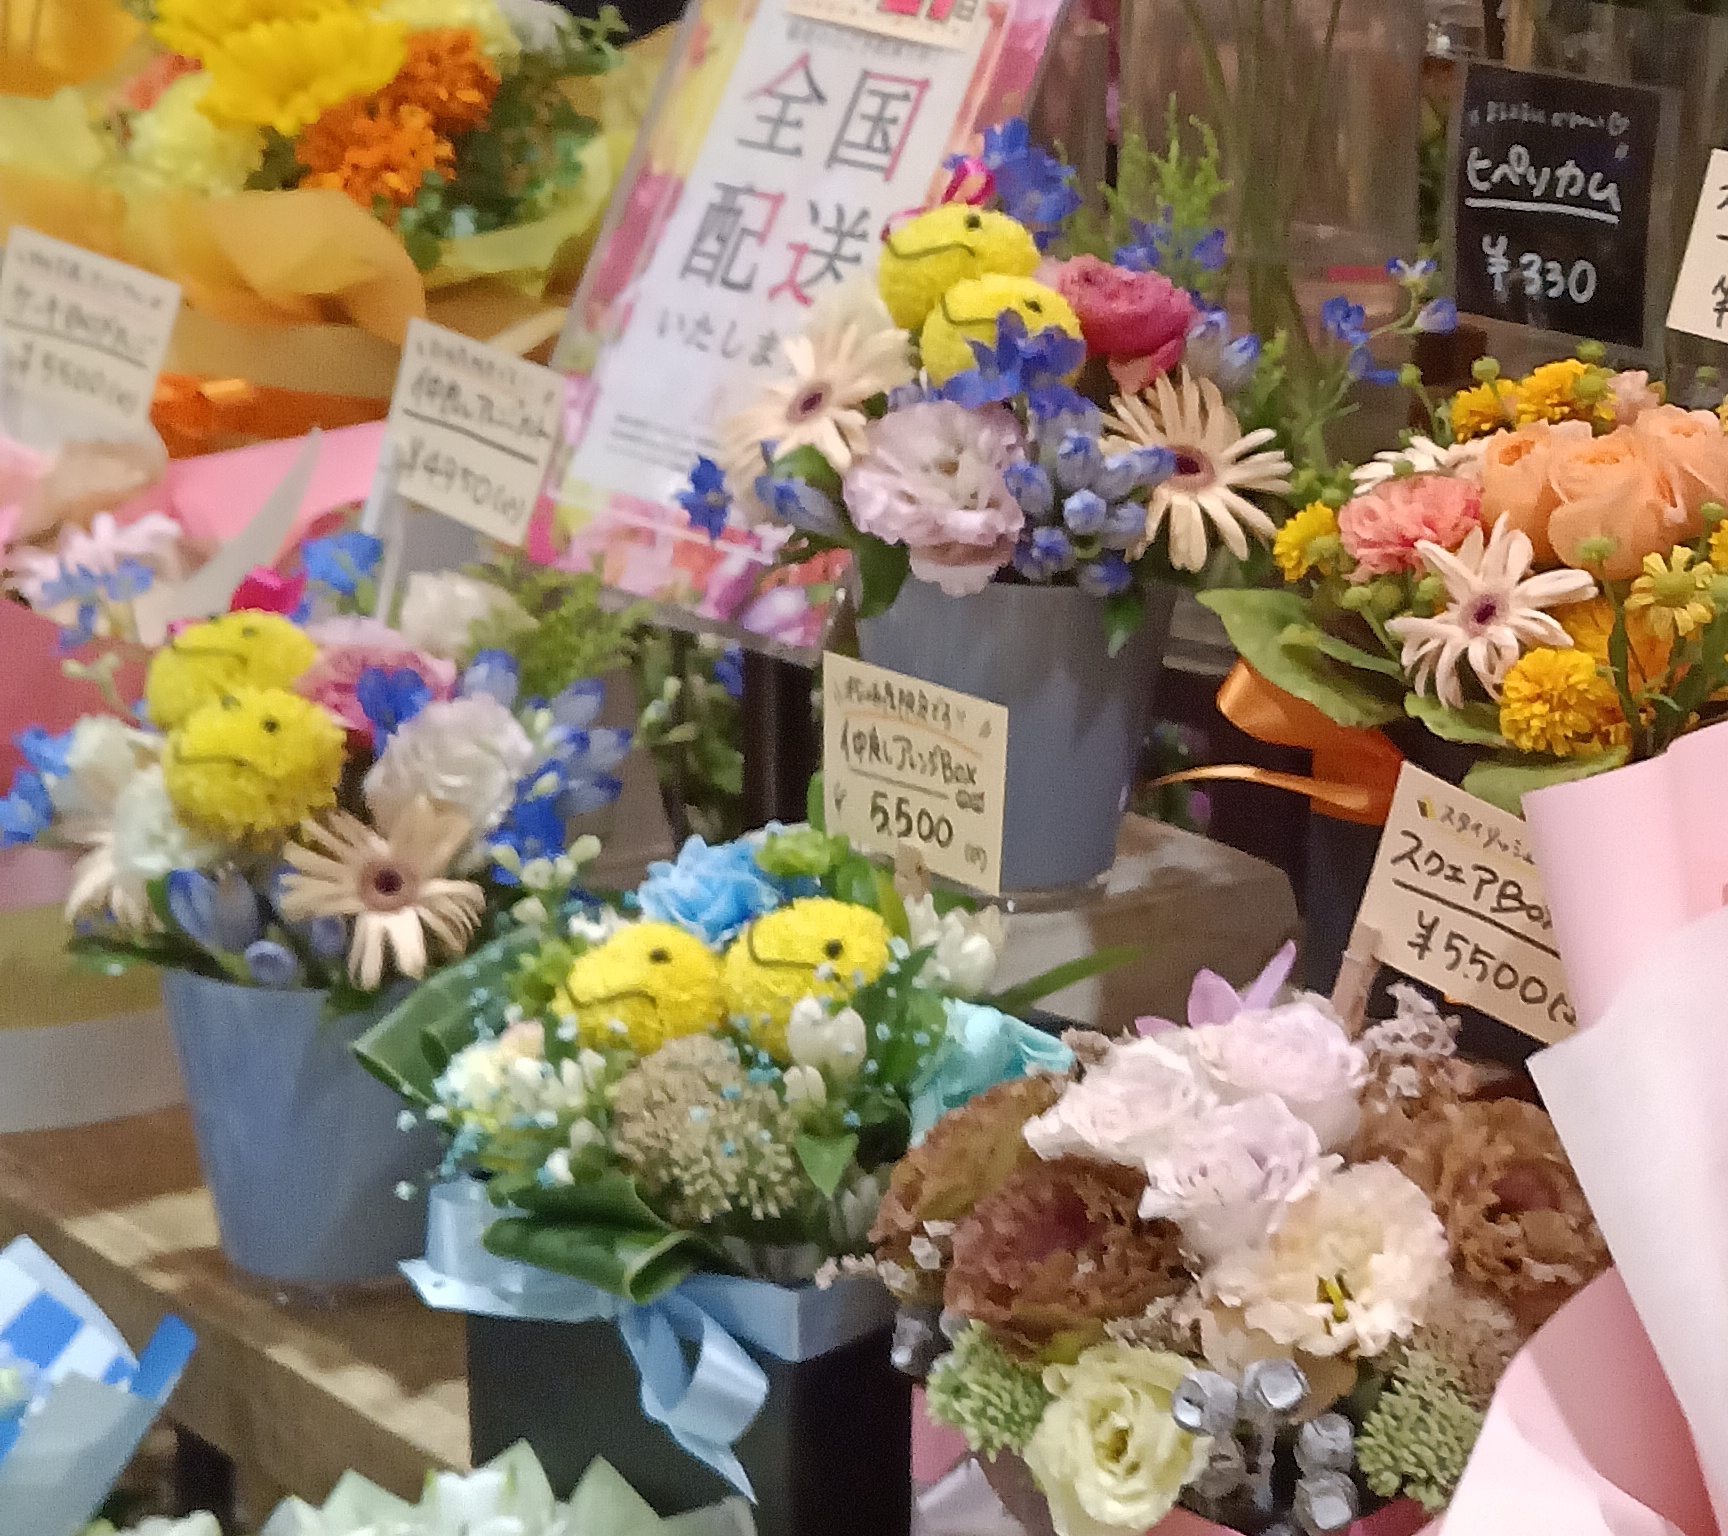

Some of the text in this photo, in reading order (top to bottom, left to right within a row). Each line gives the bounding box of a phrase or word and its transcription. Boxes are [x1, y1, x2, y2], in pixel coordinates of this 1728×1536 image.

[736, 52, 932, 183] 全国
[1465, 143, 1622, 213] ヒペリカム
[680, 181, 872, 307] 配送
[1481, 234, 1597, 305] ¥330
[656, 307, 798, 377] いたしま
